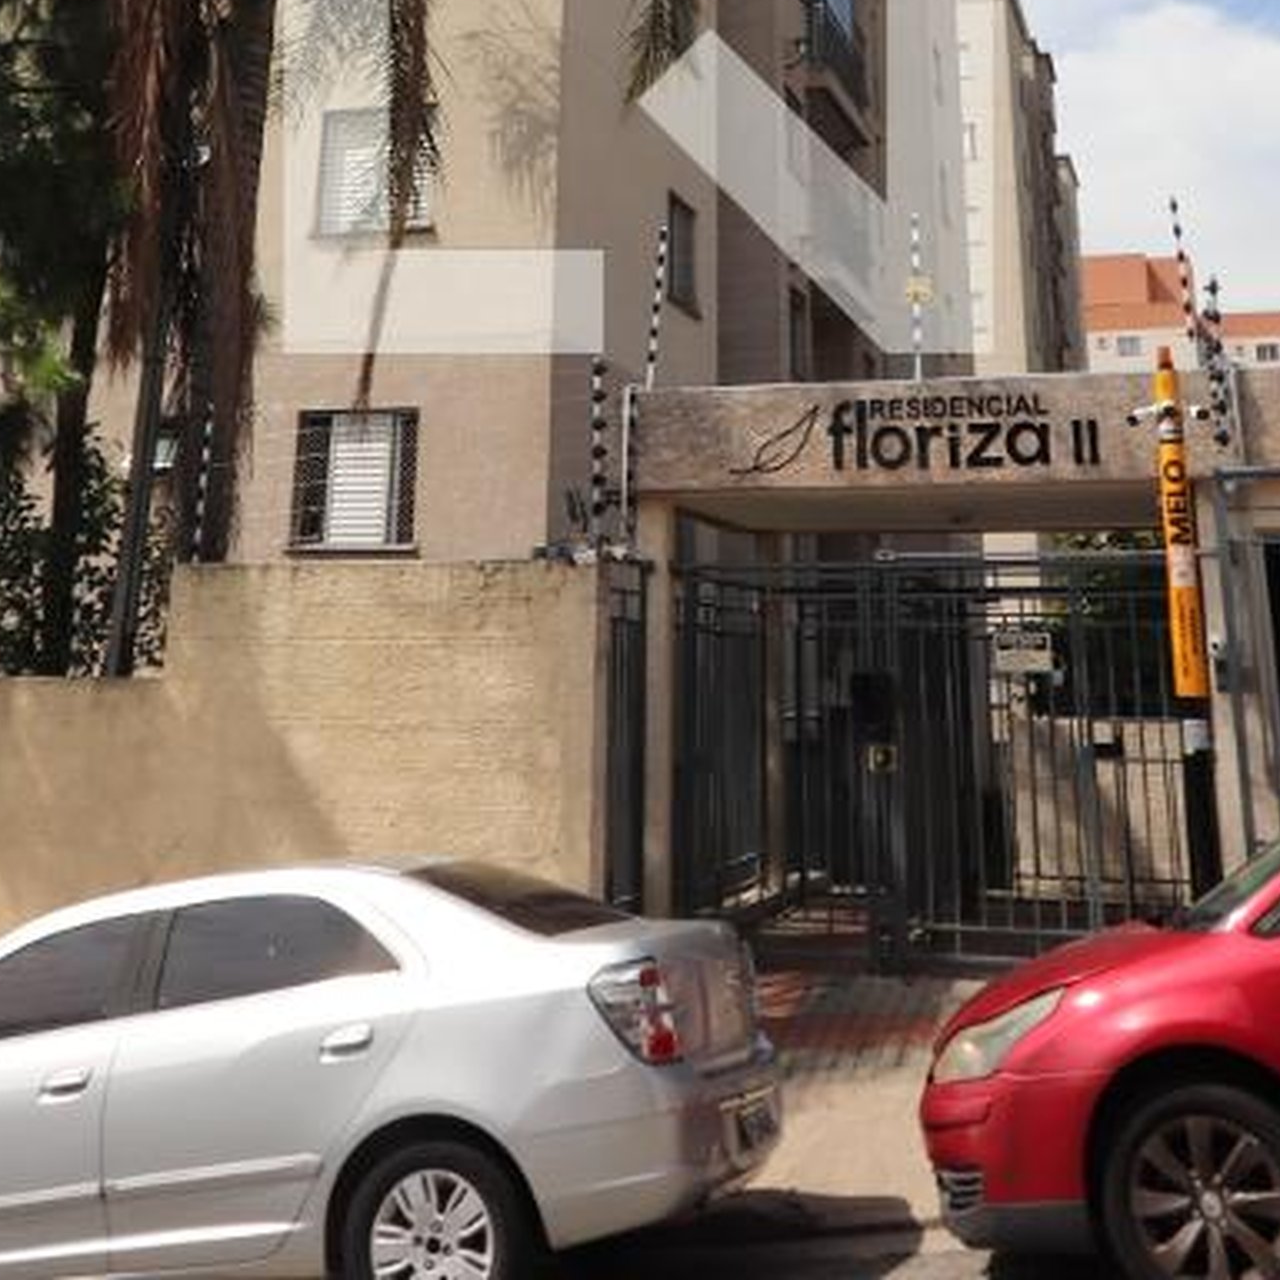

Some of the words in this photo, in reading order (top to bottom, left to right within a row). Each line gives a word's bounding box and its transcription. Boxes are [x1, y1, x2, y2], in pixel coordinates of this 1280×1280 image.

[827, 398, 1051, 470] floriza
[870, 394, 1050, 420] RESIDENCIAL
[1162, 460, 1192, 545] MELO
